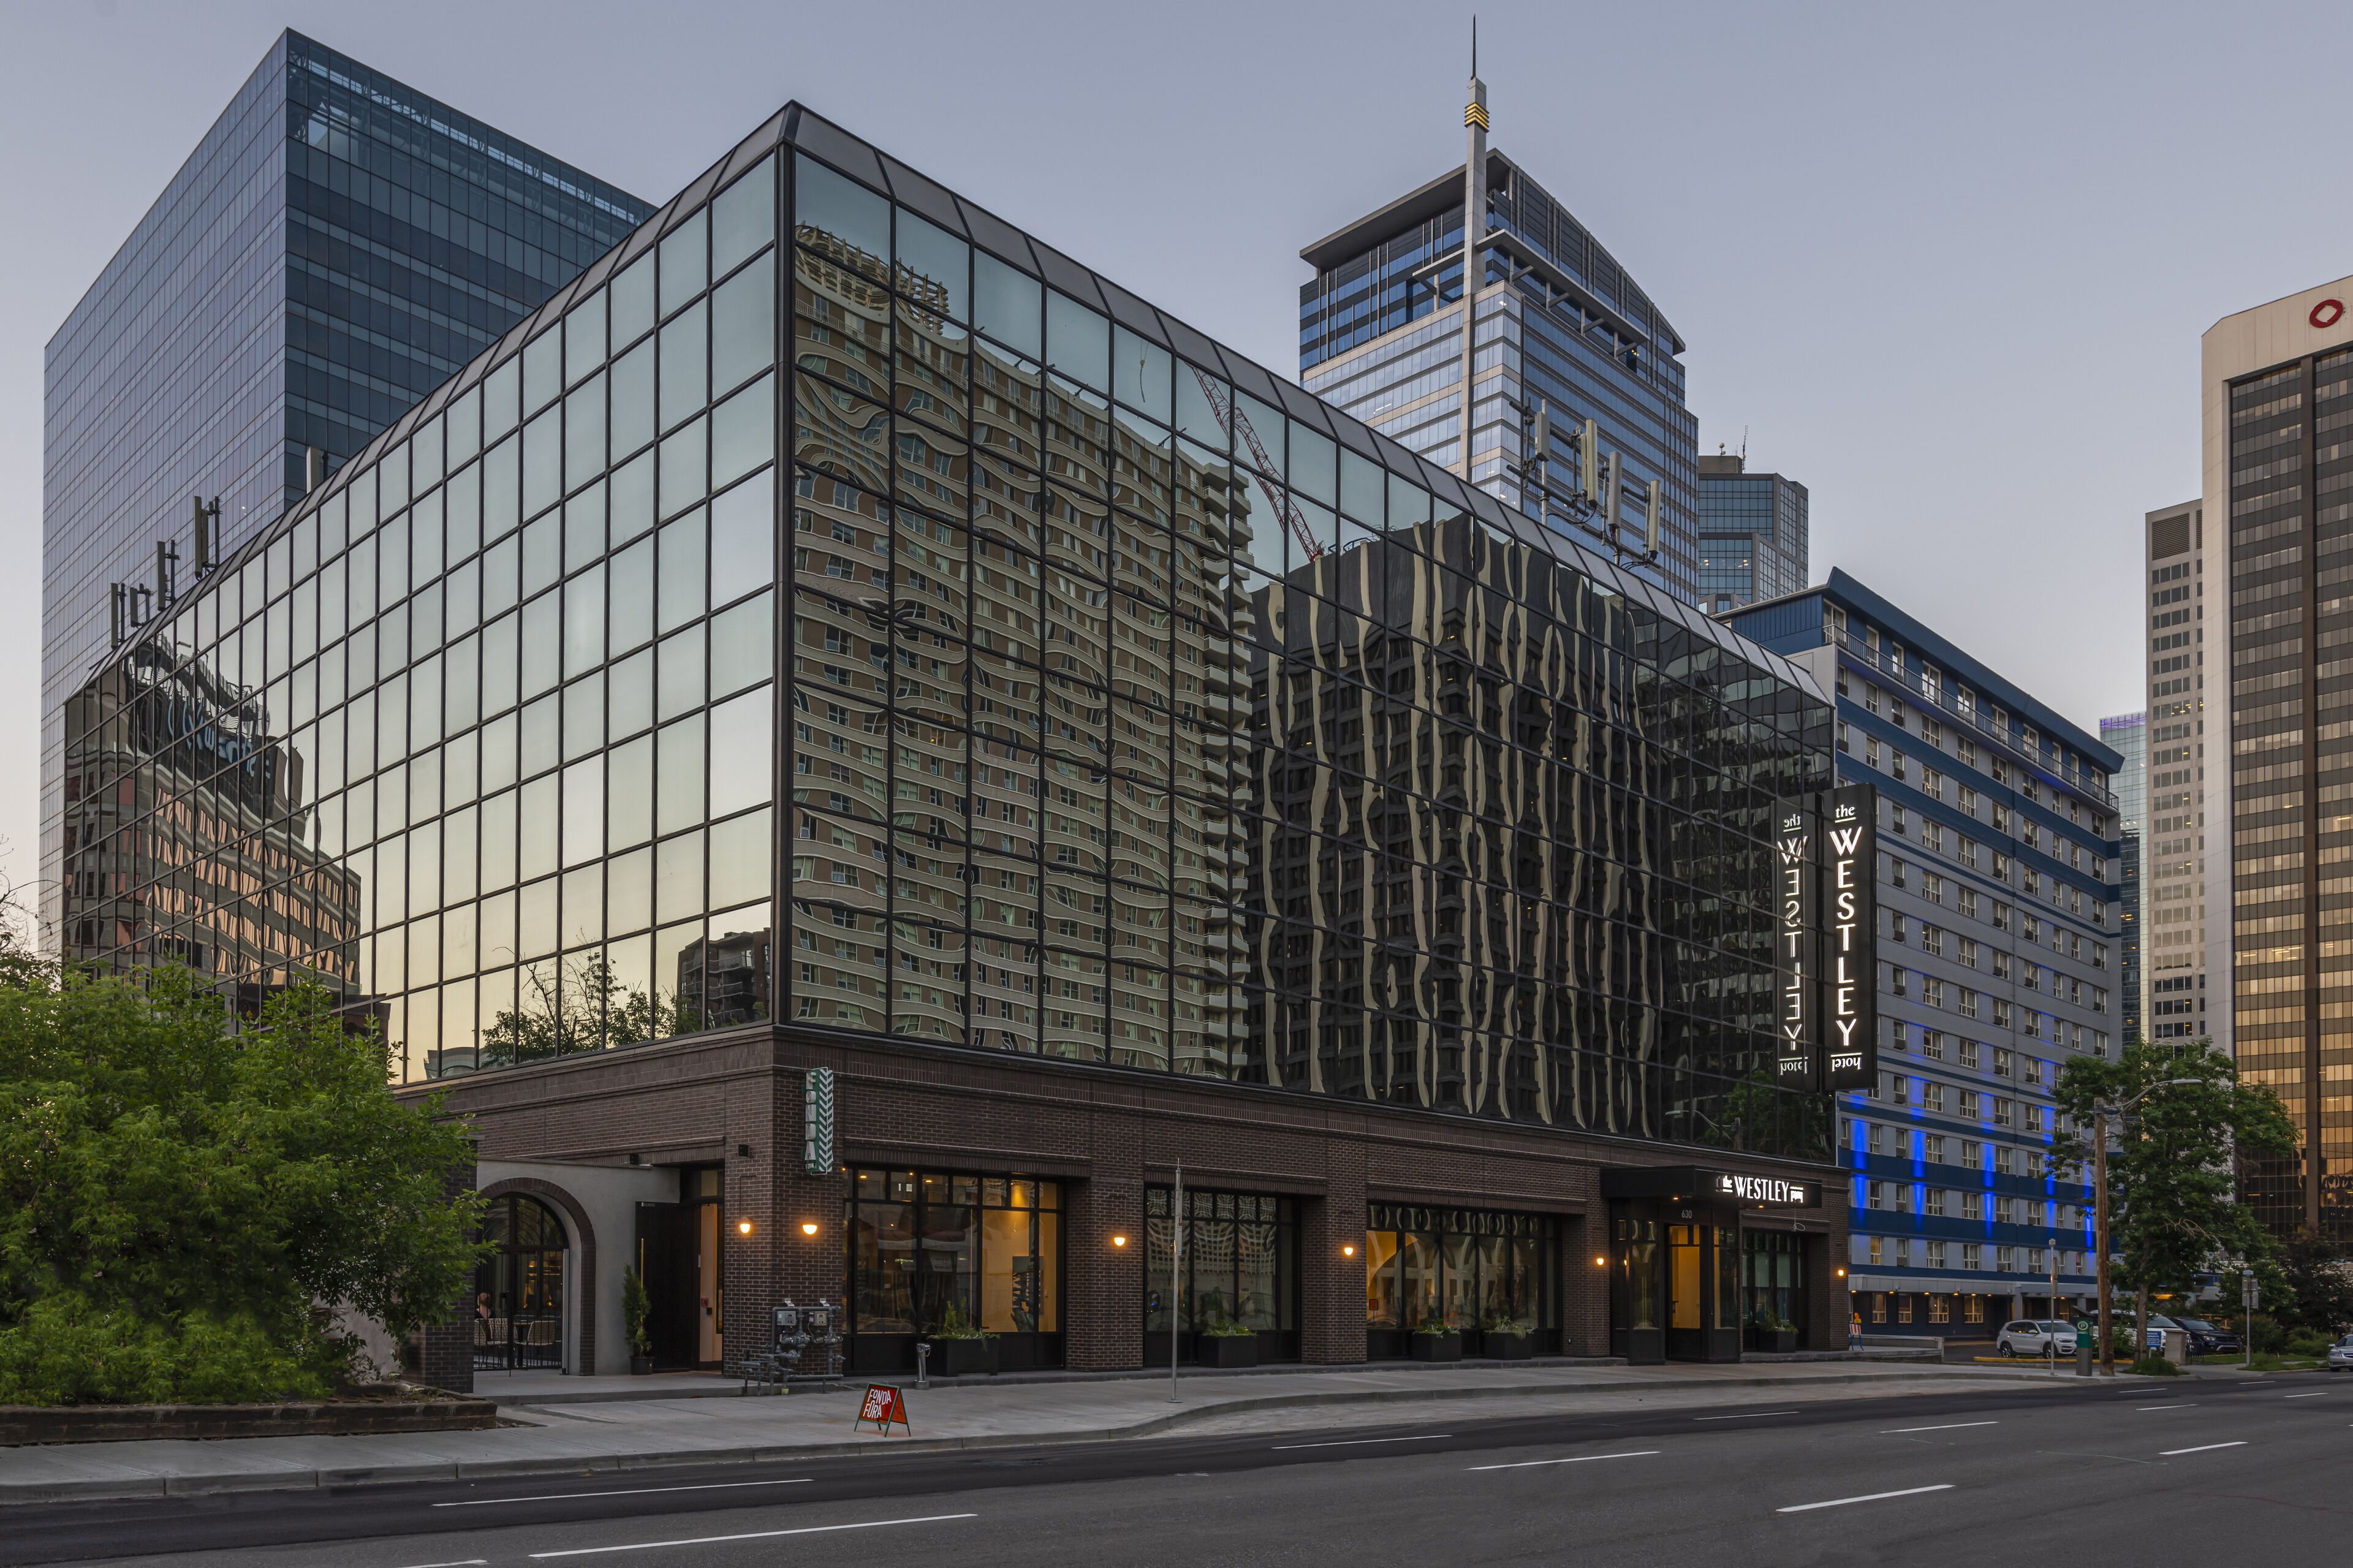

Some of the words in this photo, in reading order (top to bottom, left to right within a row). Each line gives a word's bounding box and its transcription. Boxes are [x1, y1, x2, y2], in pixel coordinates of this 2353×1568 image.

[1835, 804, 1856, 818] the
[1829, 826, 1862, 1047] WESTLEY
[1832, 1057, 1862, 1072] hotel
[1733, 1175, 1789, 1202] WESTLEY
[1681, 1210, 1692, 1219] 630
[867, 1388, 892, 1406] FONDA
[863, 1399, 882, 1418] FORA
